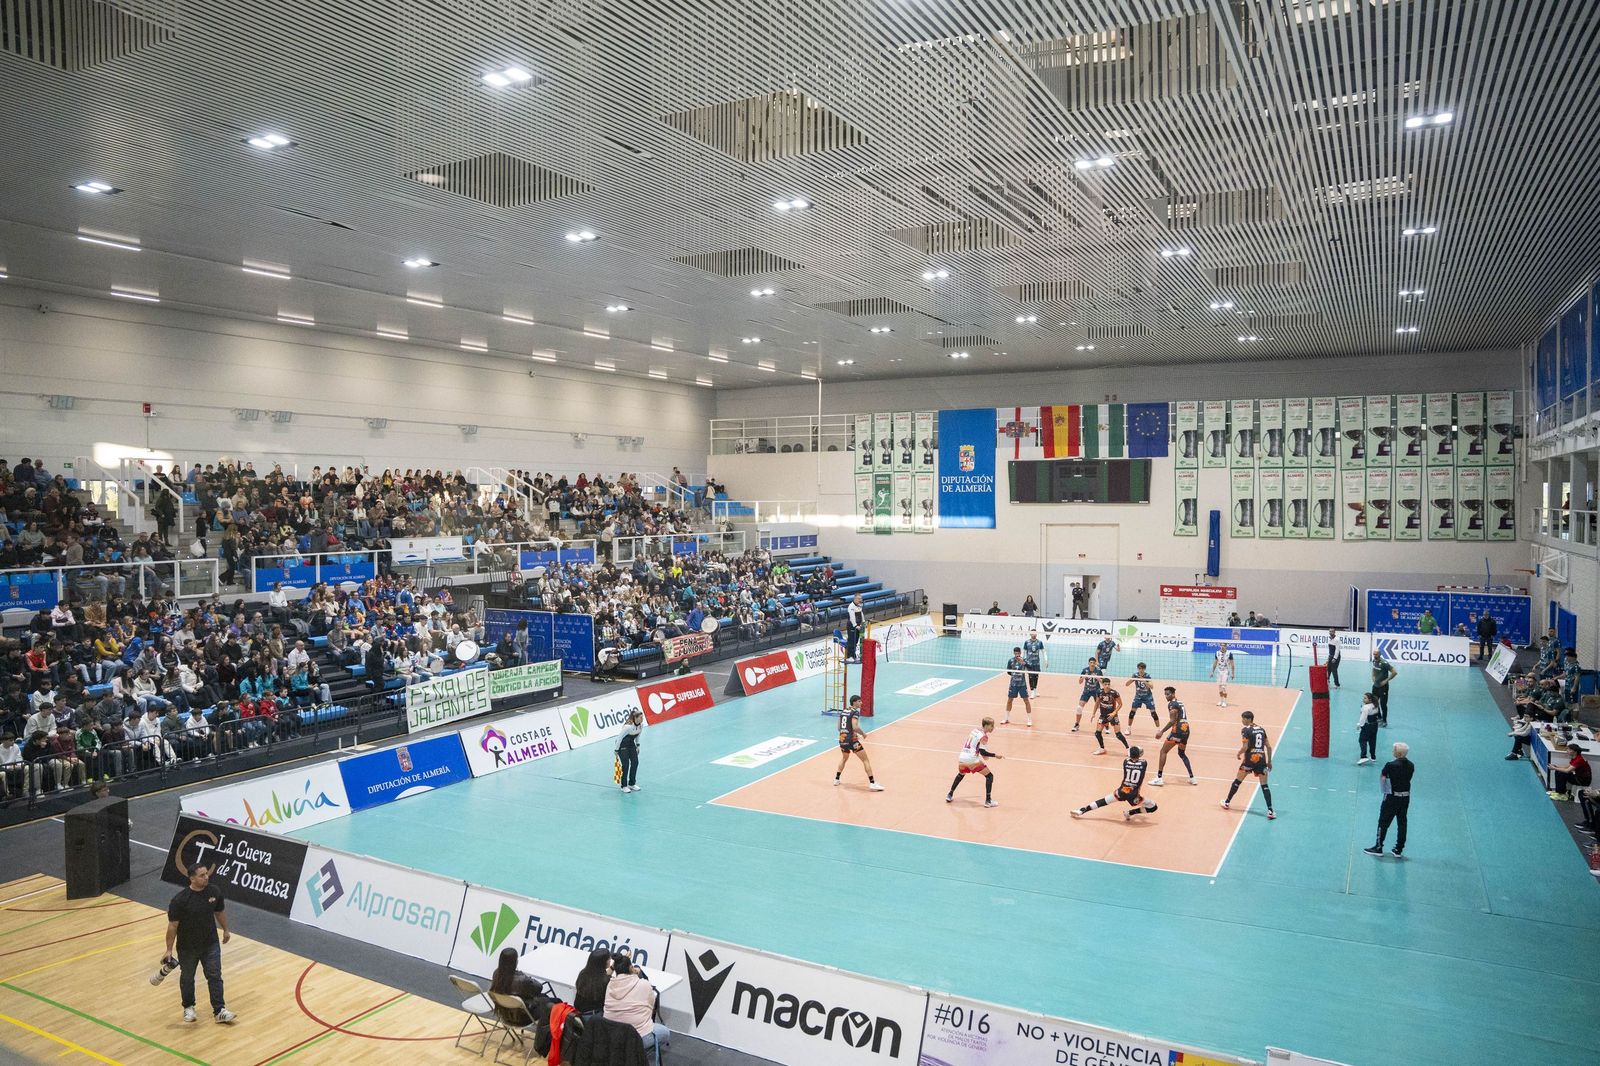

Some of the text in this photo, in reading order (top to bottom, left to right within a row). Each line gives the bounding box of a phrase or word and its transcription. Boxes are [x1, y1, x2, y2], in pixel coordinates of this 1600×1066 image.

[941, 474, 993, 484] DIPUTACIÓN
[942, 484, 992, 493] DE ALMERÍA
[1058, 626, 1107, 635] macron
[1140, 632, 1188, 648] Unicaja
[1401, 639, 1429, 650] RUIZ
[1401, 652, 1466, 664] COLLADO
[766, 663, 789, 676] SUPERLIGA
[523, 680, 533, 689] LA
[676, 688, 706, 703] SUPERLIGA
[410, 690, 487, 728] JALEANTES
[841, 716, 847, 728] 8
[510, 726, 552, 746] COSTA DE
[1255, 733, 1262, 748] 6
[507, 738, 558, 766] ALMERÍA
[754, 739, 804, 757] Unicaja
[367, 765, 451, 794] DIPUTACIÓN DE ALMERÍA
[1125, 769, 1141, 783] 10
[215, 834, 272, 865] La Cueva
[217, 859, 290, 899] de Tomasa
[345, 880, 451, 935] Alprosan
[526, 914, 649, 966] Fundación
[731, 980, 902, 1059] macron
[934, 1003, 990, 1034] #016
[937, 1036, 961, 1046] VIOLENCIA
[1017, 1022, 1044, 1040] NO
[1050, 1031, 1060, 1041] +
[1064, 1032, 1162, 1066] VIOLENCIA
[1056, 1049, 1079, 1066] DE
